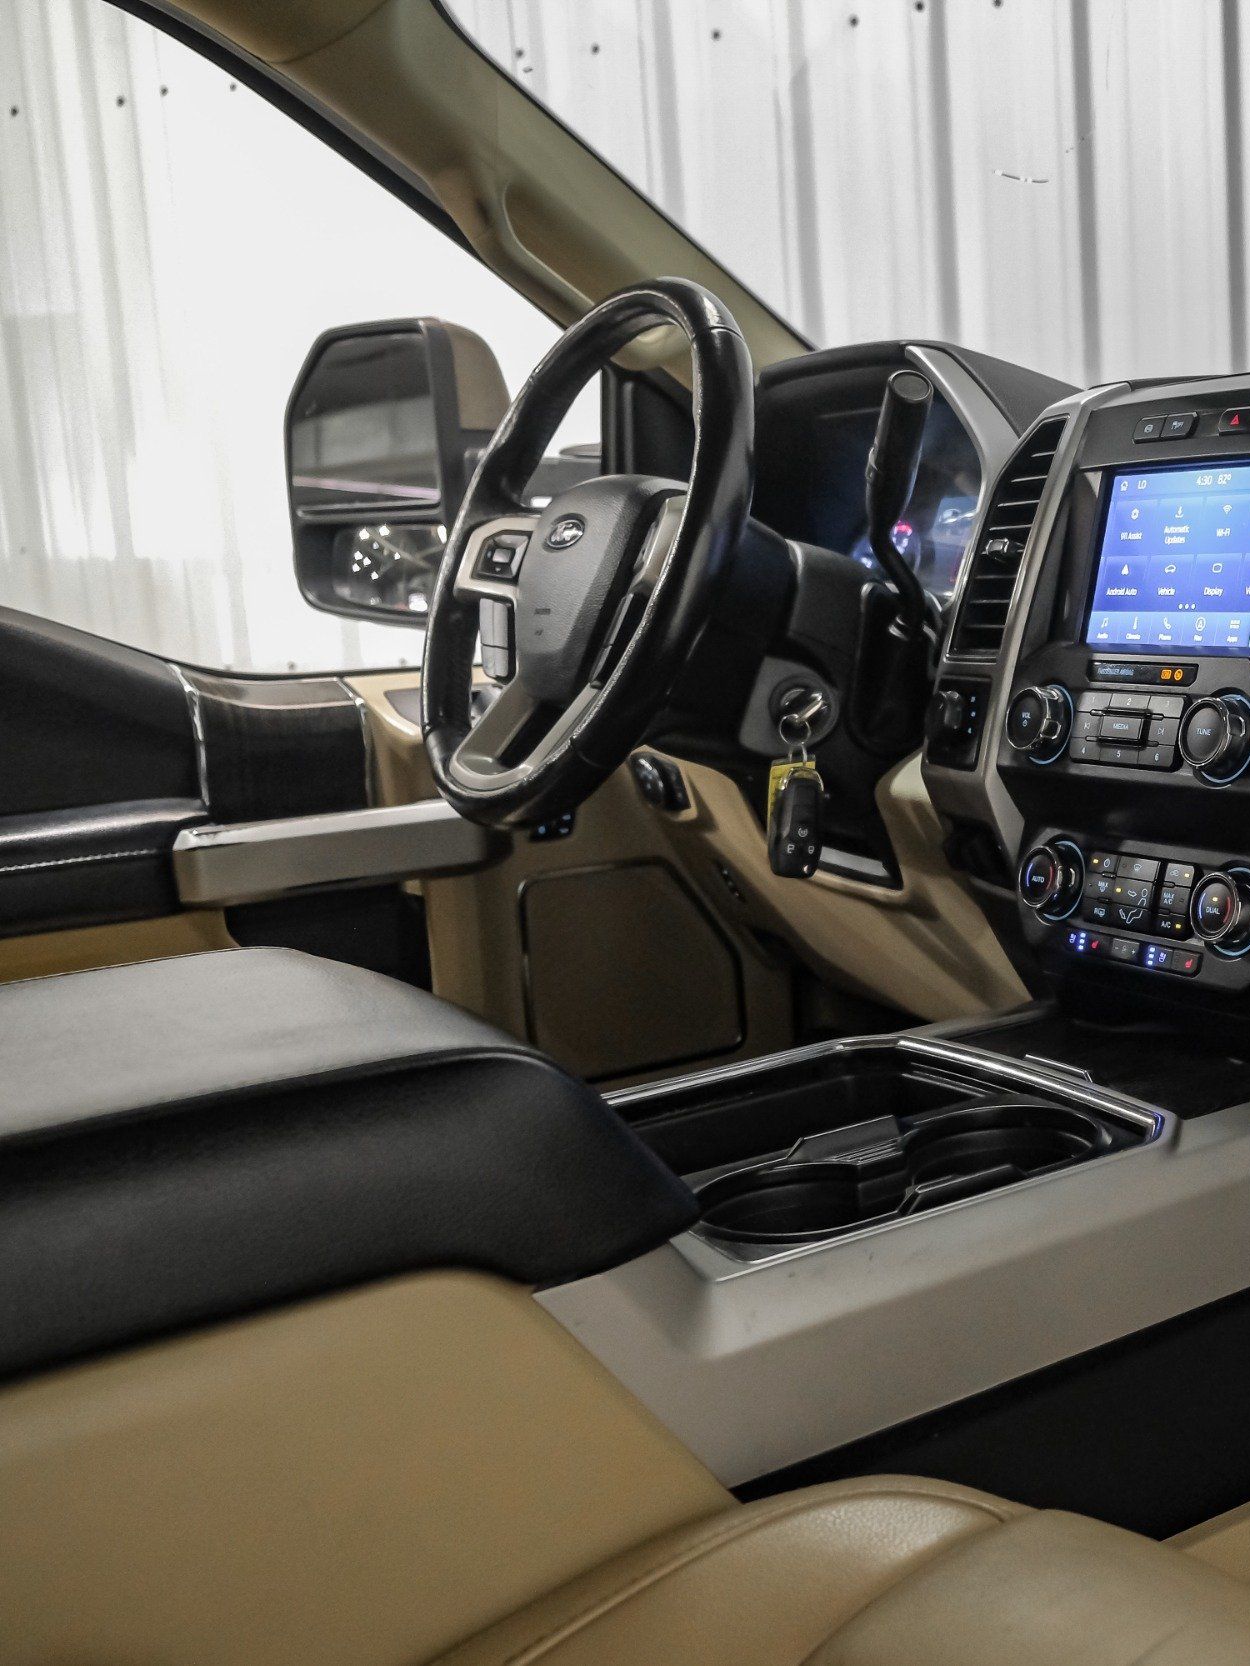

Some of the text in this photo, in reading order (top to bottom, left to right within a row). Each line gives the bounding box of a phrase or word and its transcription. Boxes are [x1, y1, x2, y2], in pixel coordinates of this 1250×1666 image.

[1196, 474, 1213, 487] 4:30
[1163, 525, 1190, 534] Automatic
[1164, 535, 1186, 545] Updates
[1106, 587, 1138, 596] Android Auto
[1157, 587, 1176, 596] Vehicle
[1203, 587, 1224, 597] Display
[1127, 698, 1132, 706] 2
[1195, 727, 1212, 736] TUNE
[1081, 747, 1086, 755] 4
[1116, 750, 1121, 758] 5
[1154, 753, 1159, 761] 6
[1031, 875, 1045, 884] AUTO
[1163, 891, 1175, 899] MAX
[1205, 907, 1220, 915] DUAL
[1160, 920, 1171, 928] A/C
